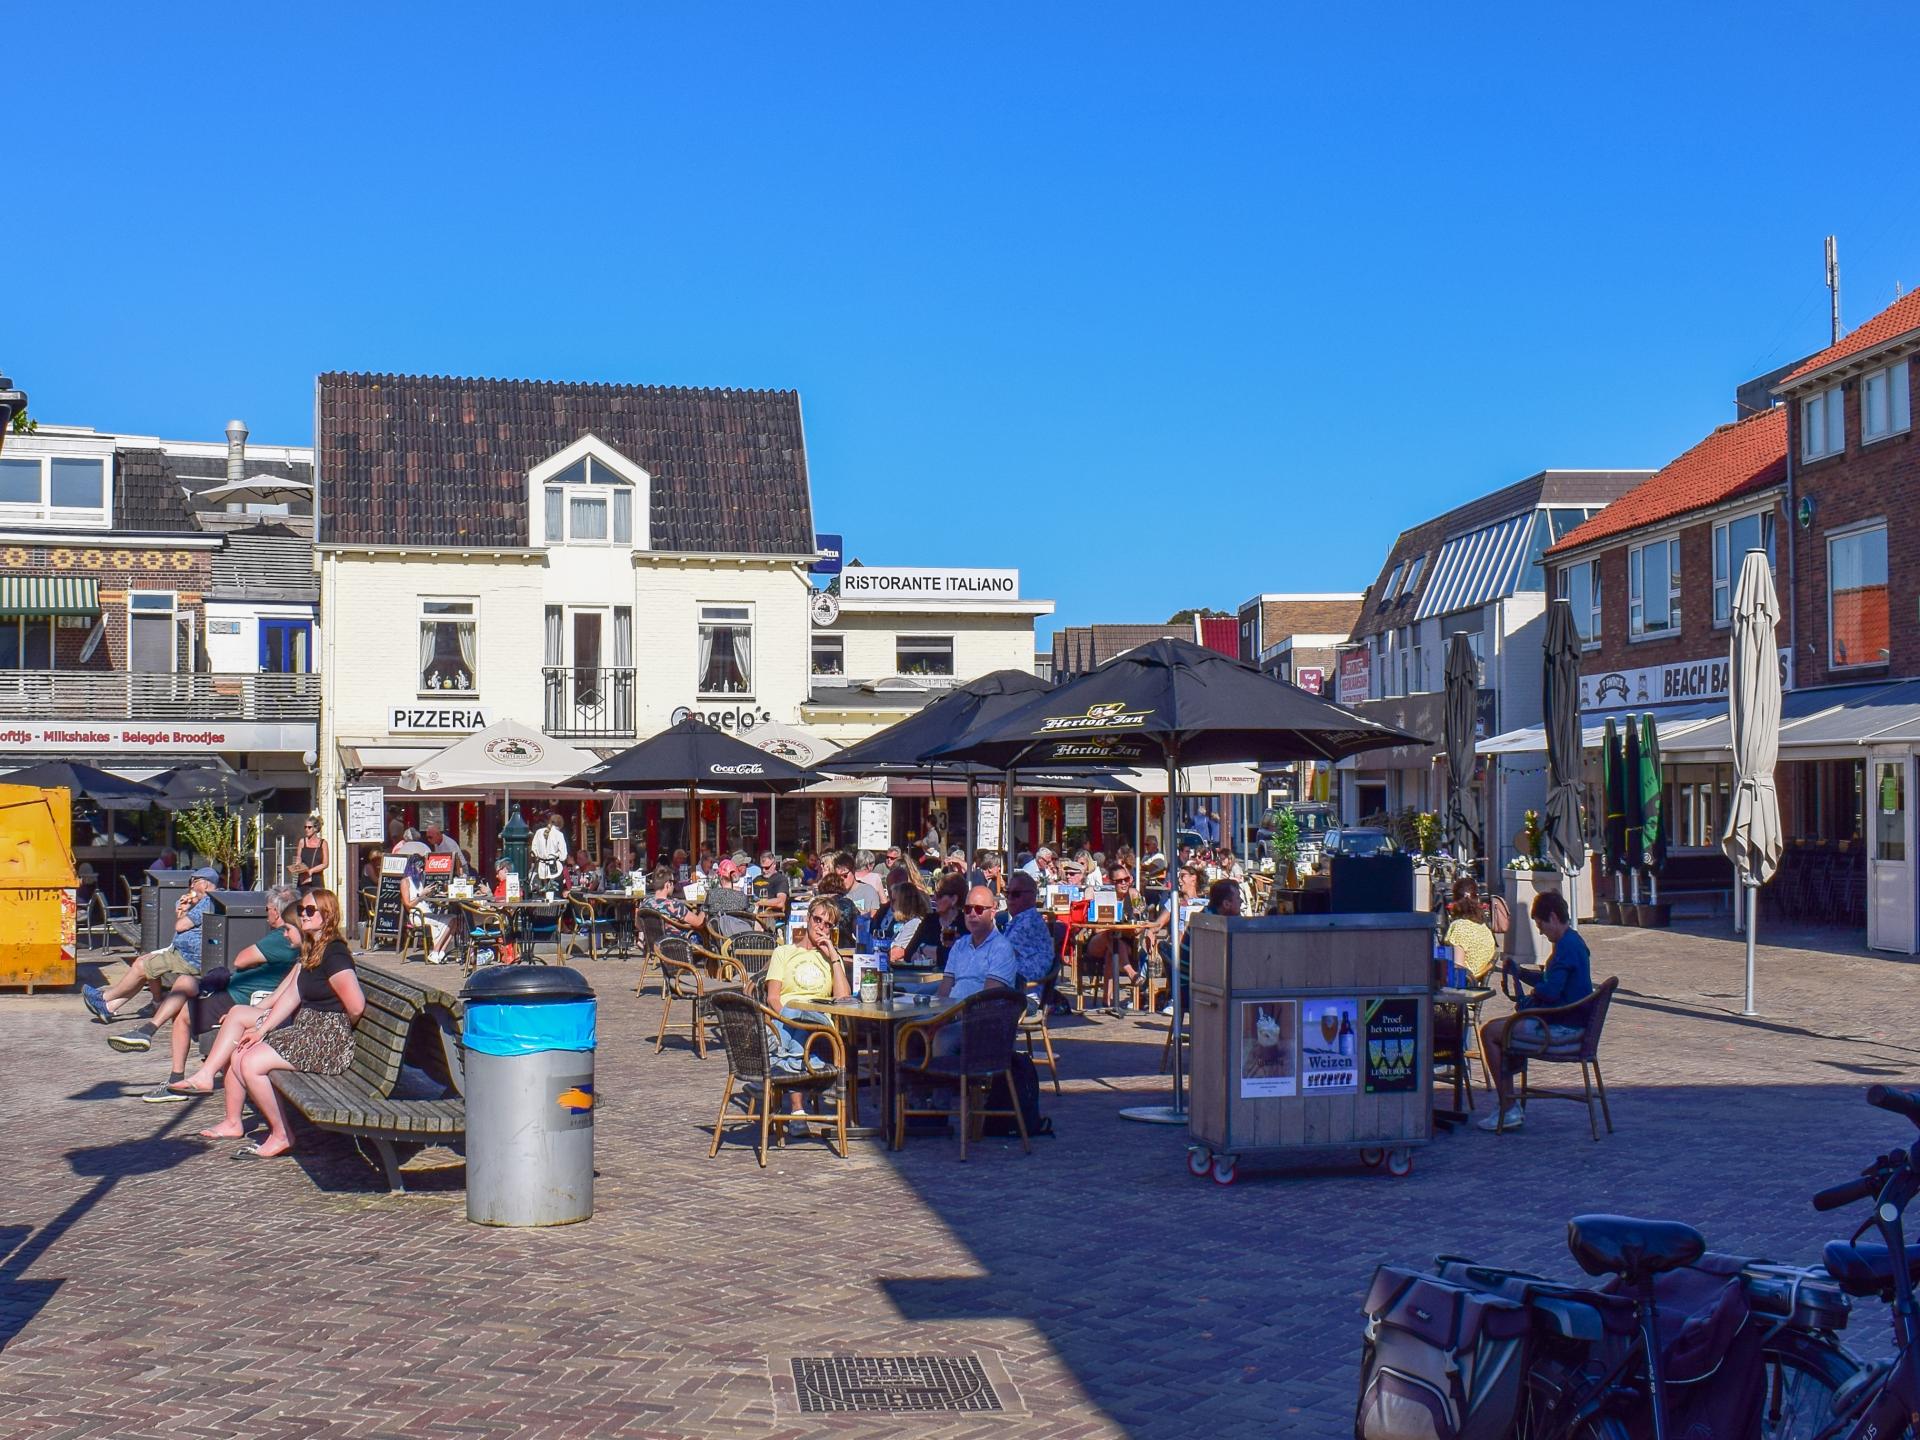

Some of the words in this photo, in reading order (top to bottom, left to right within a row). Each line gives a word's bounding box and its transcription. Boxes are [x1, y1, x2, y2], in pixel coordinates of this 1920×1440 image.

[1663, 664, 1708, 698] BEACH
[1041, 718, 1109, 732] Hertog
[0, 730, 32, 745] oftijs
[43, 730, 111, 742] Milkshakes
[122, 731, 170, 745] Belegde
[173, 731, 225, 745] Broodjes
[1382, 1015, 1404, 1024] Proef
[1370, 1025, 1383, 1033] het
[1384, 1025, 1413, 1034] voorjaar
[1309, 1056, 1353, 1069] Weizen
